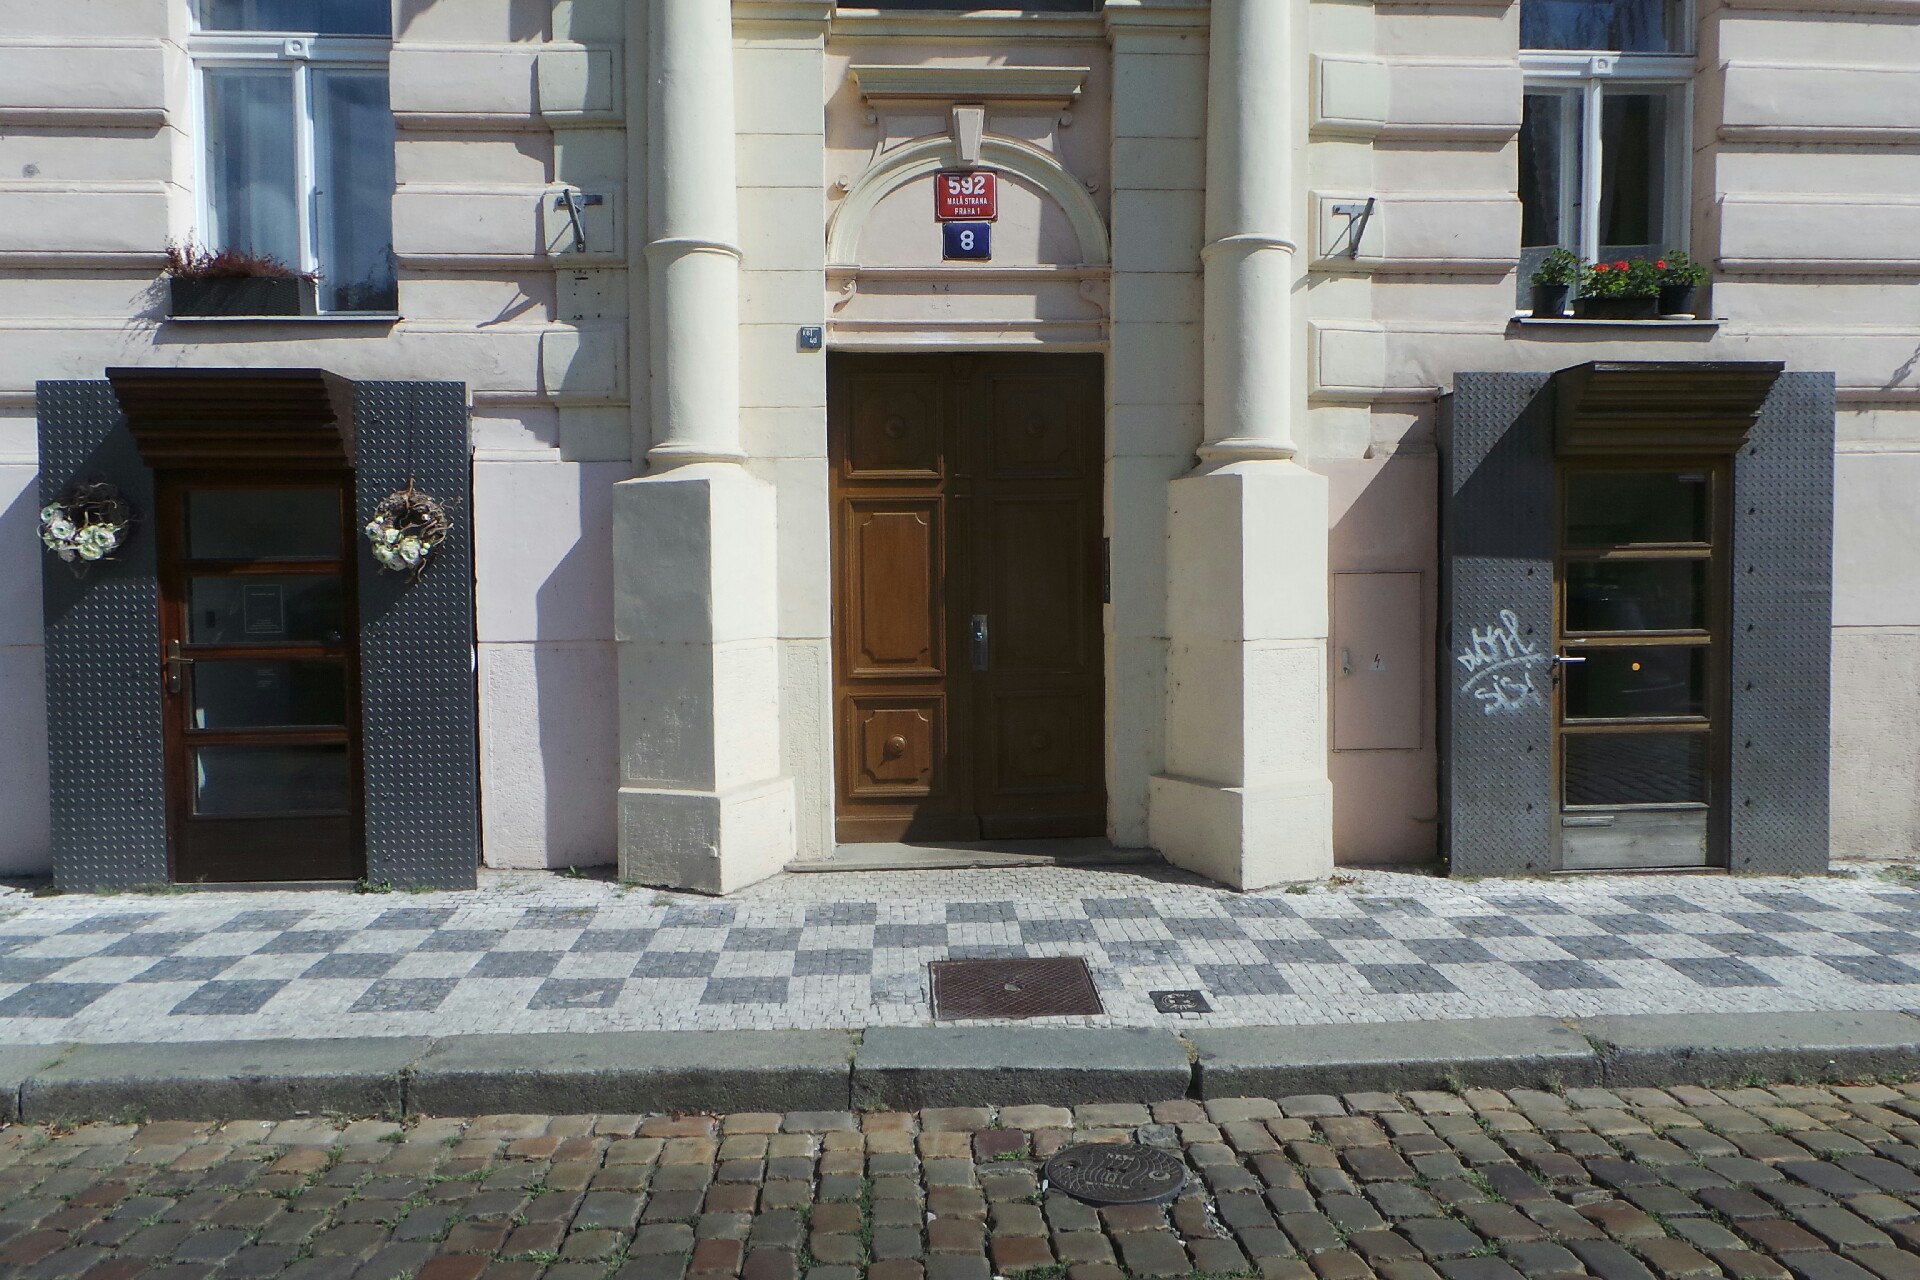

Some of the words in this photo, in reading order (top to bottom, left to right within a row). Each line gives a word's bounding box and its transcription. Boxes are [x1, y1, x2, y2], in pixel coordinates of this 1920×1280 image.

[948, 175, 985, 195] 592
[946, 196, 963, 205] MALÁ
[964, 197, 988, 205] STRANA
[954, 207, 976, 215] PRAHA
[960, 230, 975, 251] 8
